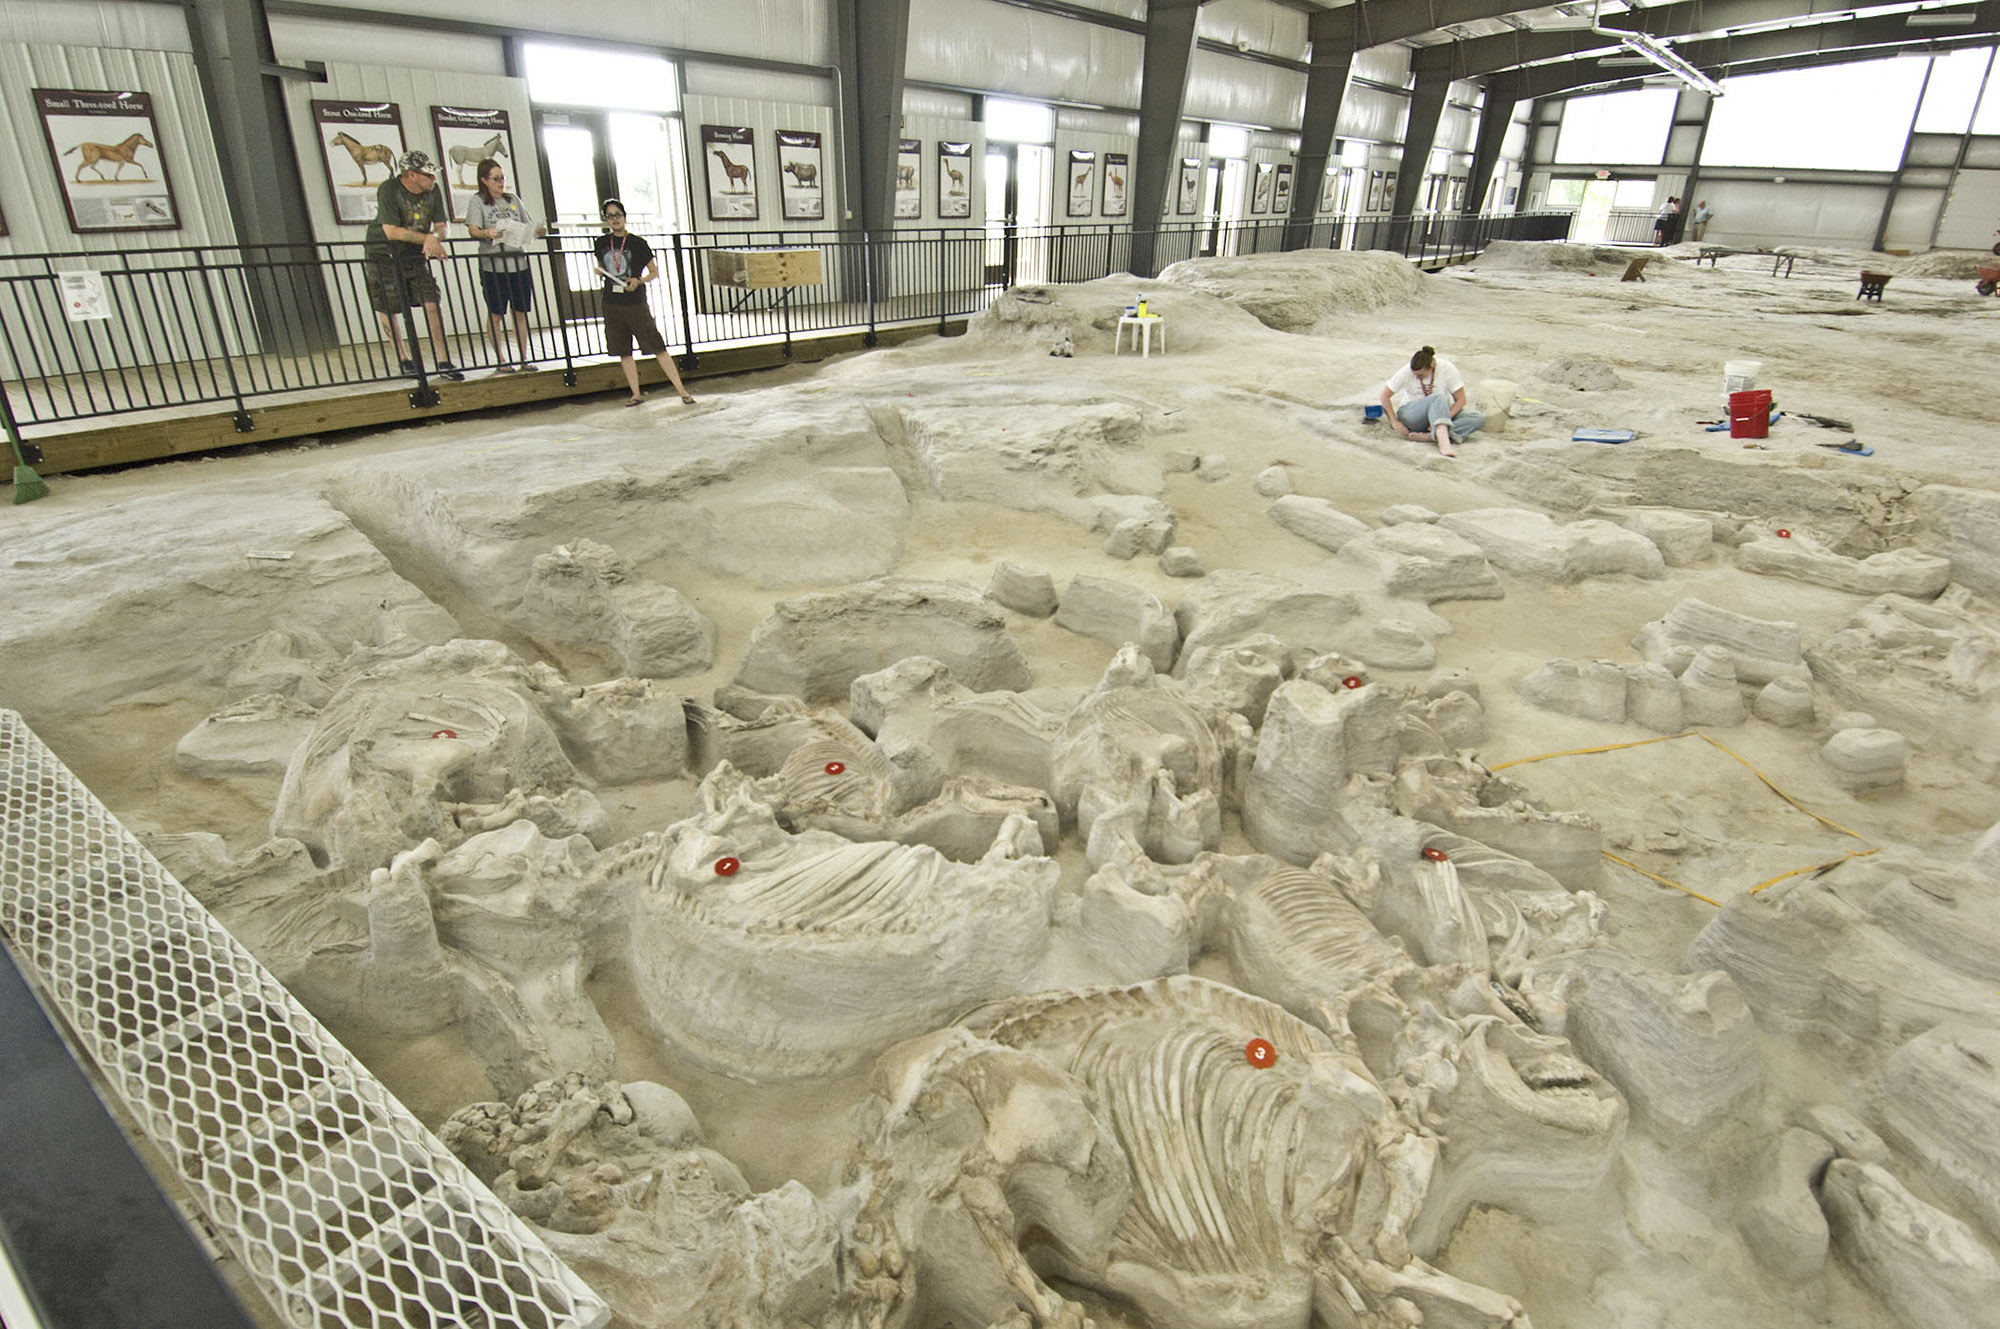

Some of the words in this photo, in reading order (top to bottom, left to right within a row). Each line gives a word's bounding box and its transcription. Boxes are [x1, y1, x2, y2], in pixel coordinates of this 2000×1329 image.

[45, 98, 71, 108] Small
[72, 99, 117, 109] Three-toed
[119, 100, 145, 110] Horse
[373, 111, 392, 119] Horse
[1255, 1047, 1266, 1060] 3
